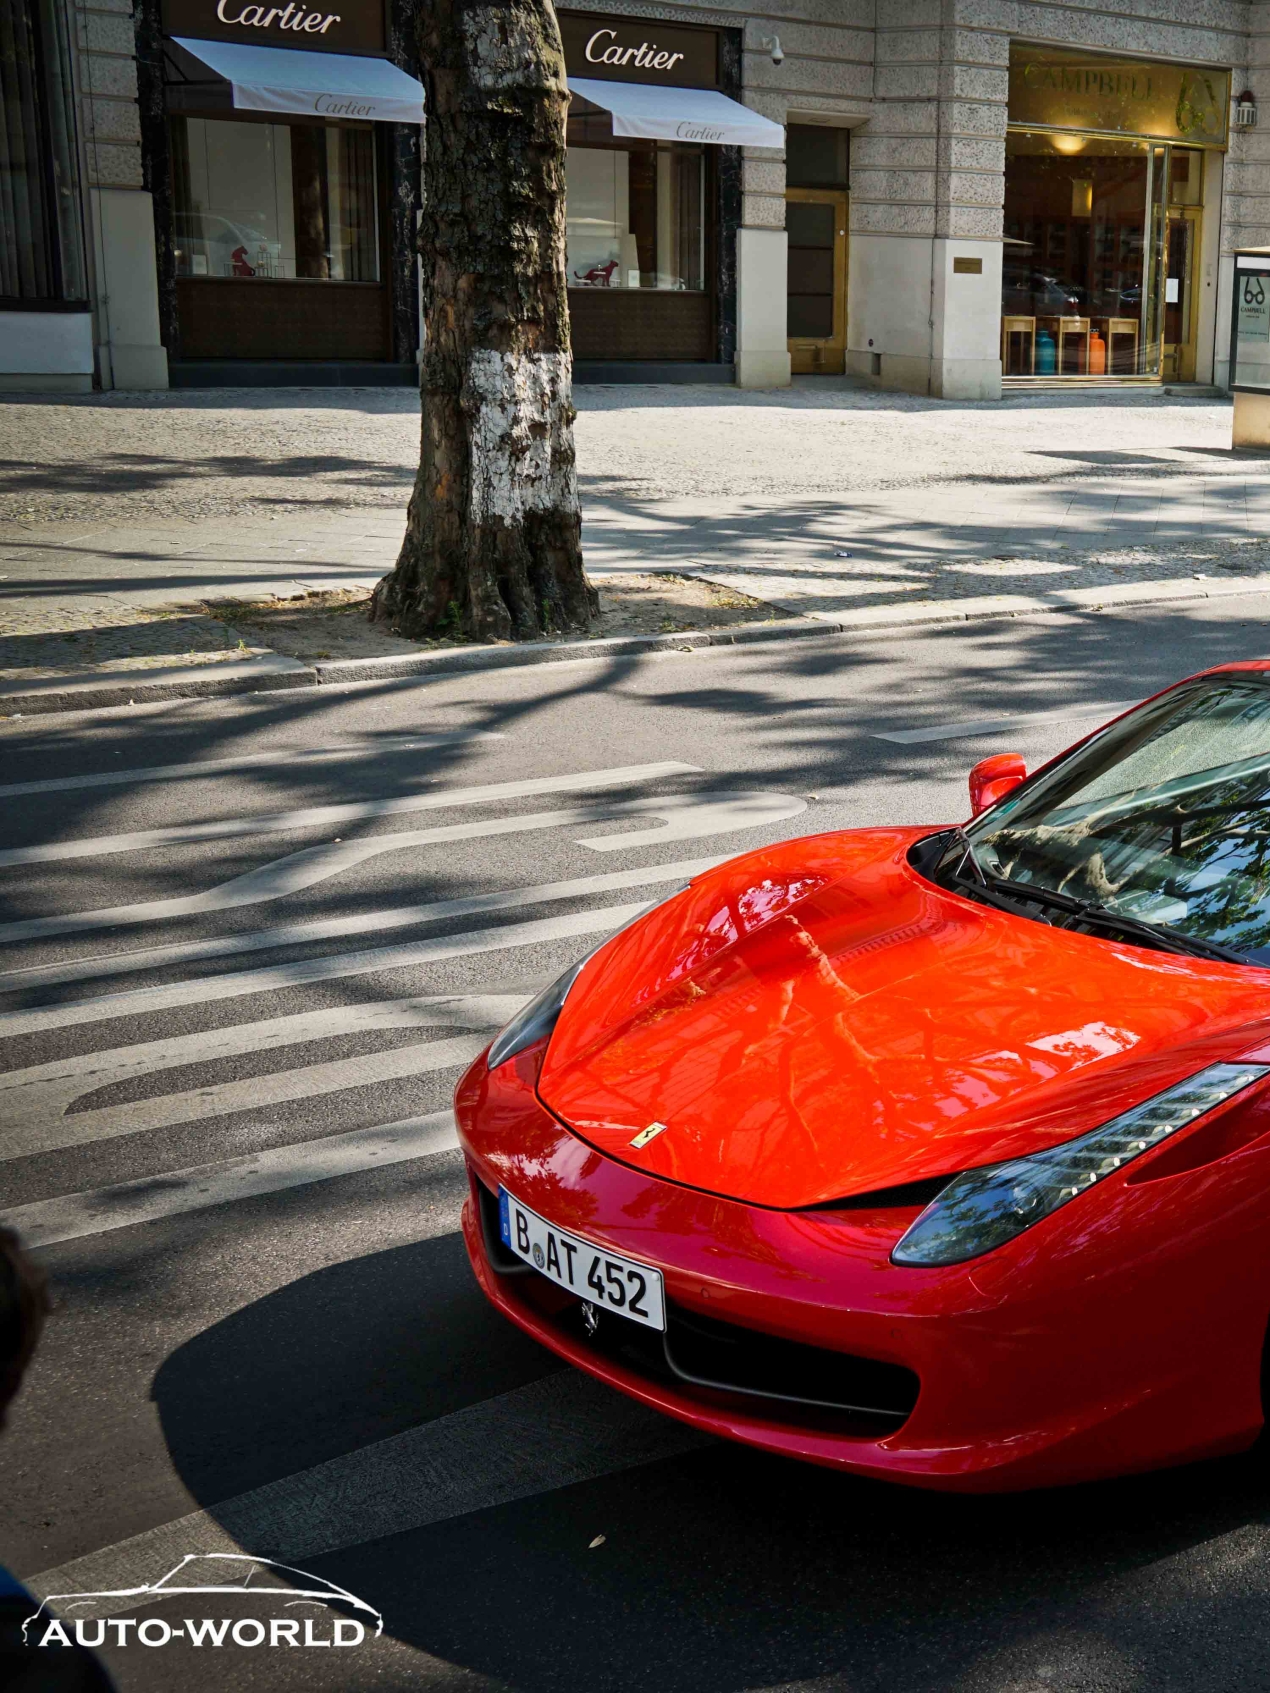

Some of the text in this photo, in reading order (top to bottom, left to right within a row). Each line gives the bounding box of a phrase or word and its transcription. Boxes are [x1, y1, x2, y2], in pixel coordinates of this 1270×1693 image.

[217, 0, 341, 34] Cartier
[585, 29, 684, 70] Cartier
[314, 93, 376, 117] Cartier
[676, 121, 725, 141] Cartier
[516, 1208, 649, 1318] B AT 452
